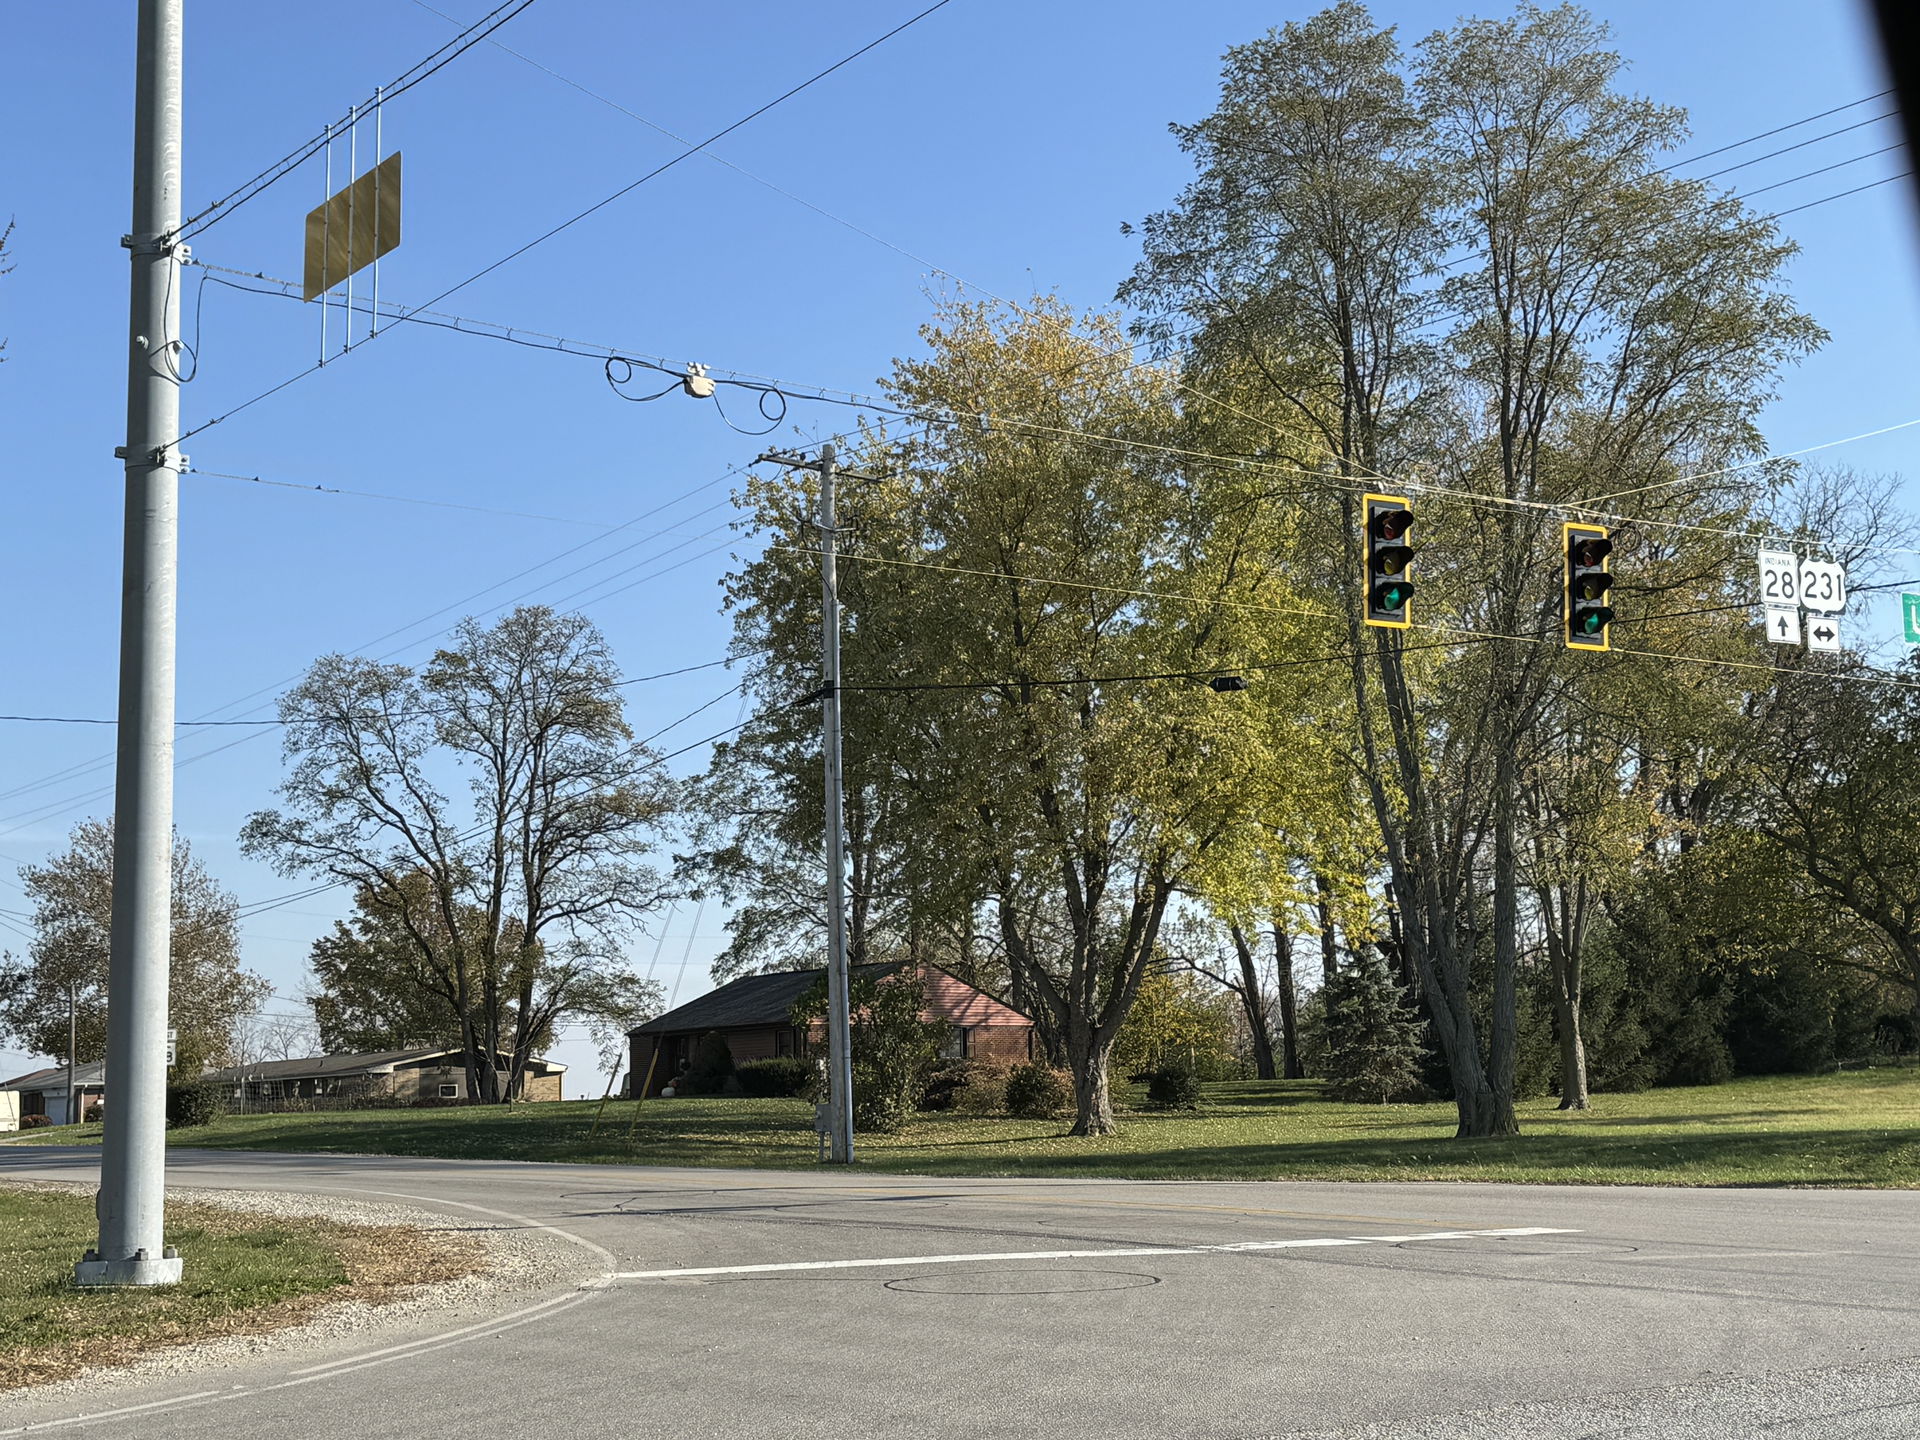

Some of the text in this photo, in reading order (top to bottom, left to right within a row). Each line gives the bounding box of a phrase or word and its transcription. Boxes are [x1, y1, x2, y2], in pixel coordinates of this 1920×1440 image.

[1764, 557, 1791, 566] INDIANA
[1764, 569, 1795, 599] 28
[1804, 570, 1842, 602] 231
